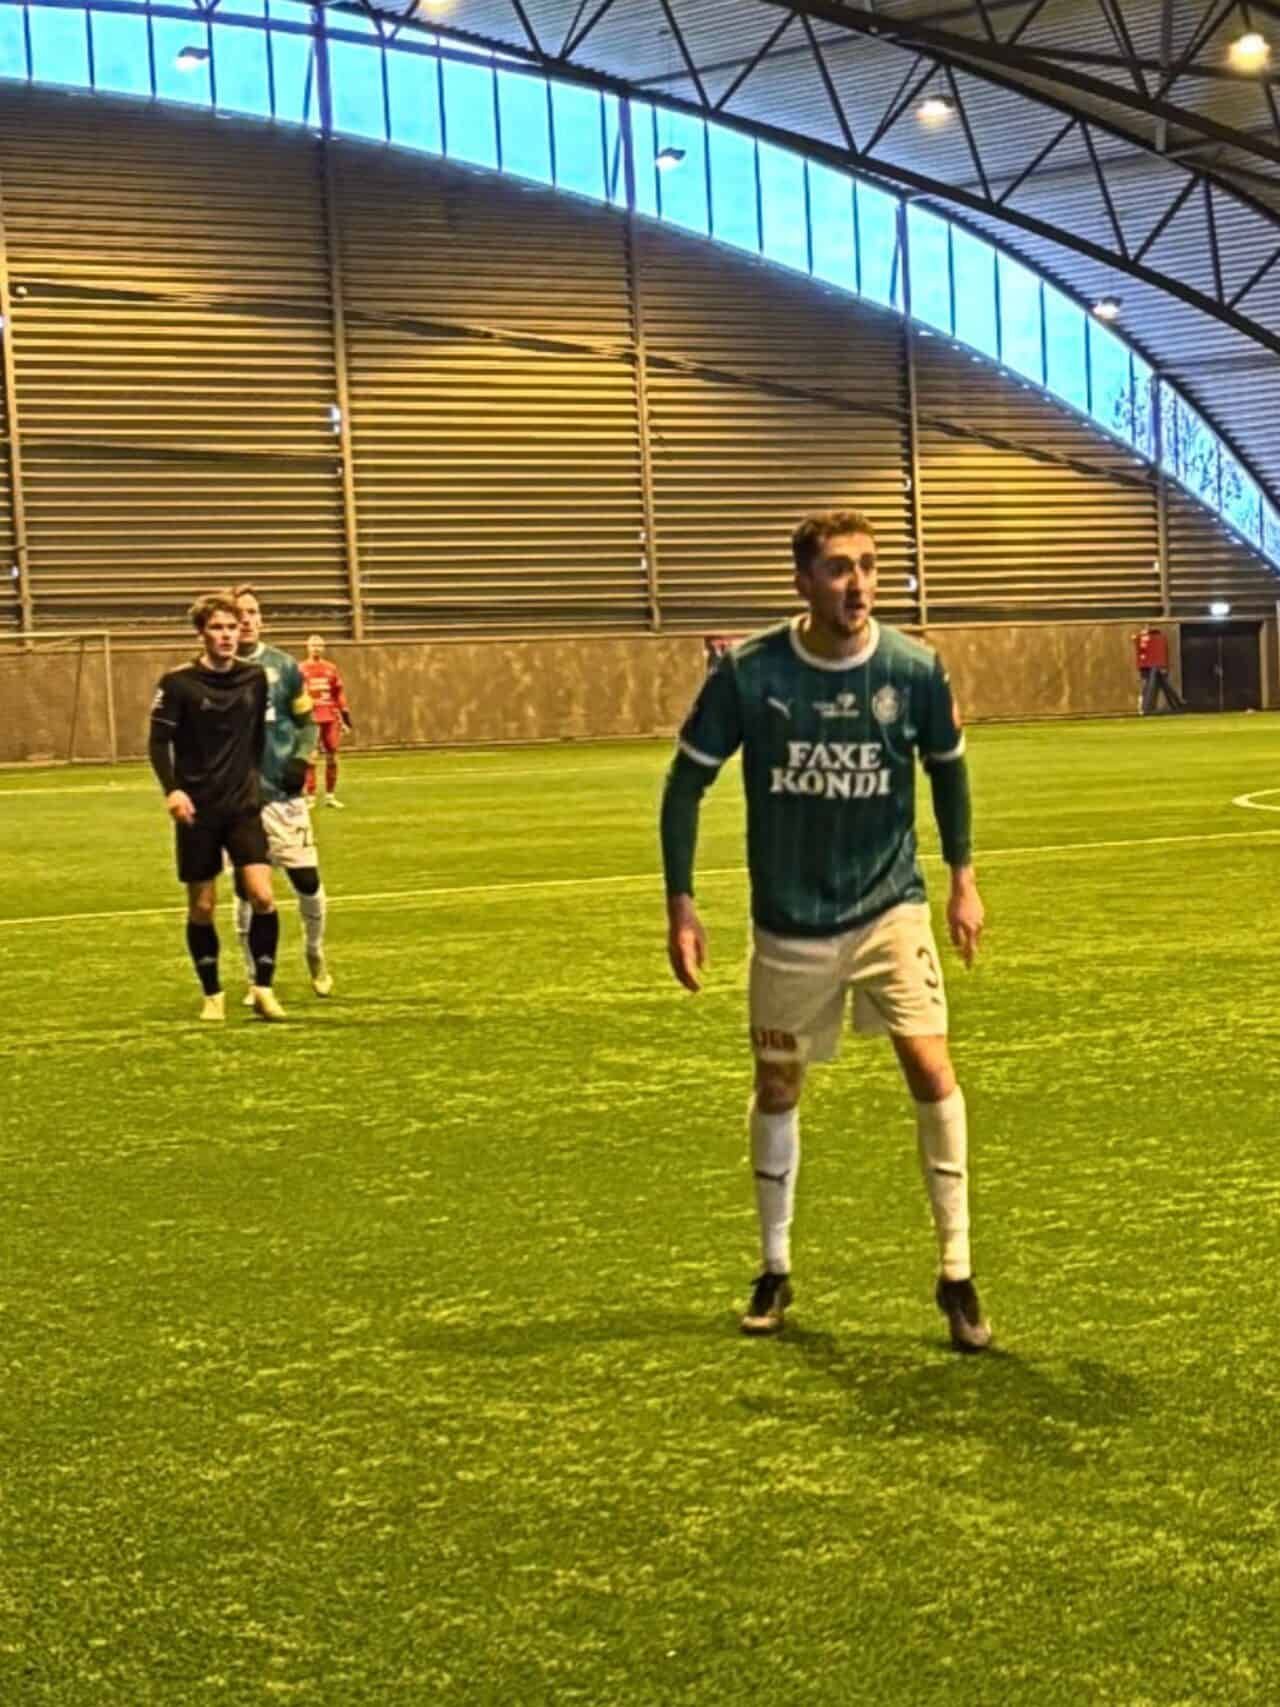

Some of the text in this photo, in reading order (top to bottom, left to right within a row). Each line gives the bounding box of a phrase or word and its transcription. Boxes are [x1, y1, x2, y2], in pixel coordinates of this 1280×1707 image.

[787, 741, 882, 769] FAXE
[769, 768, 892, 799] KONDI
[916, 946, 939, 989] 3
